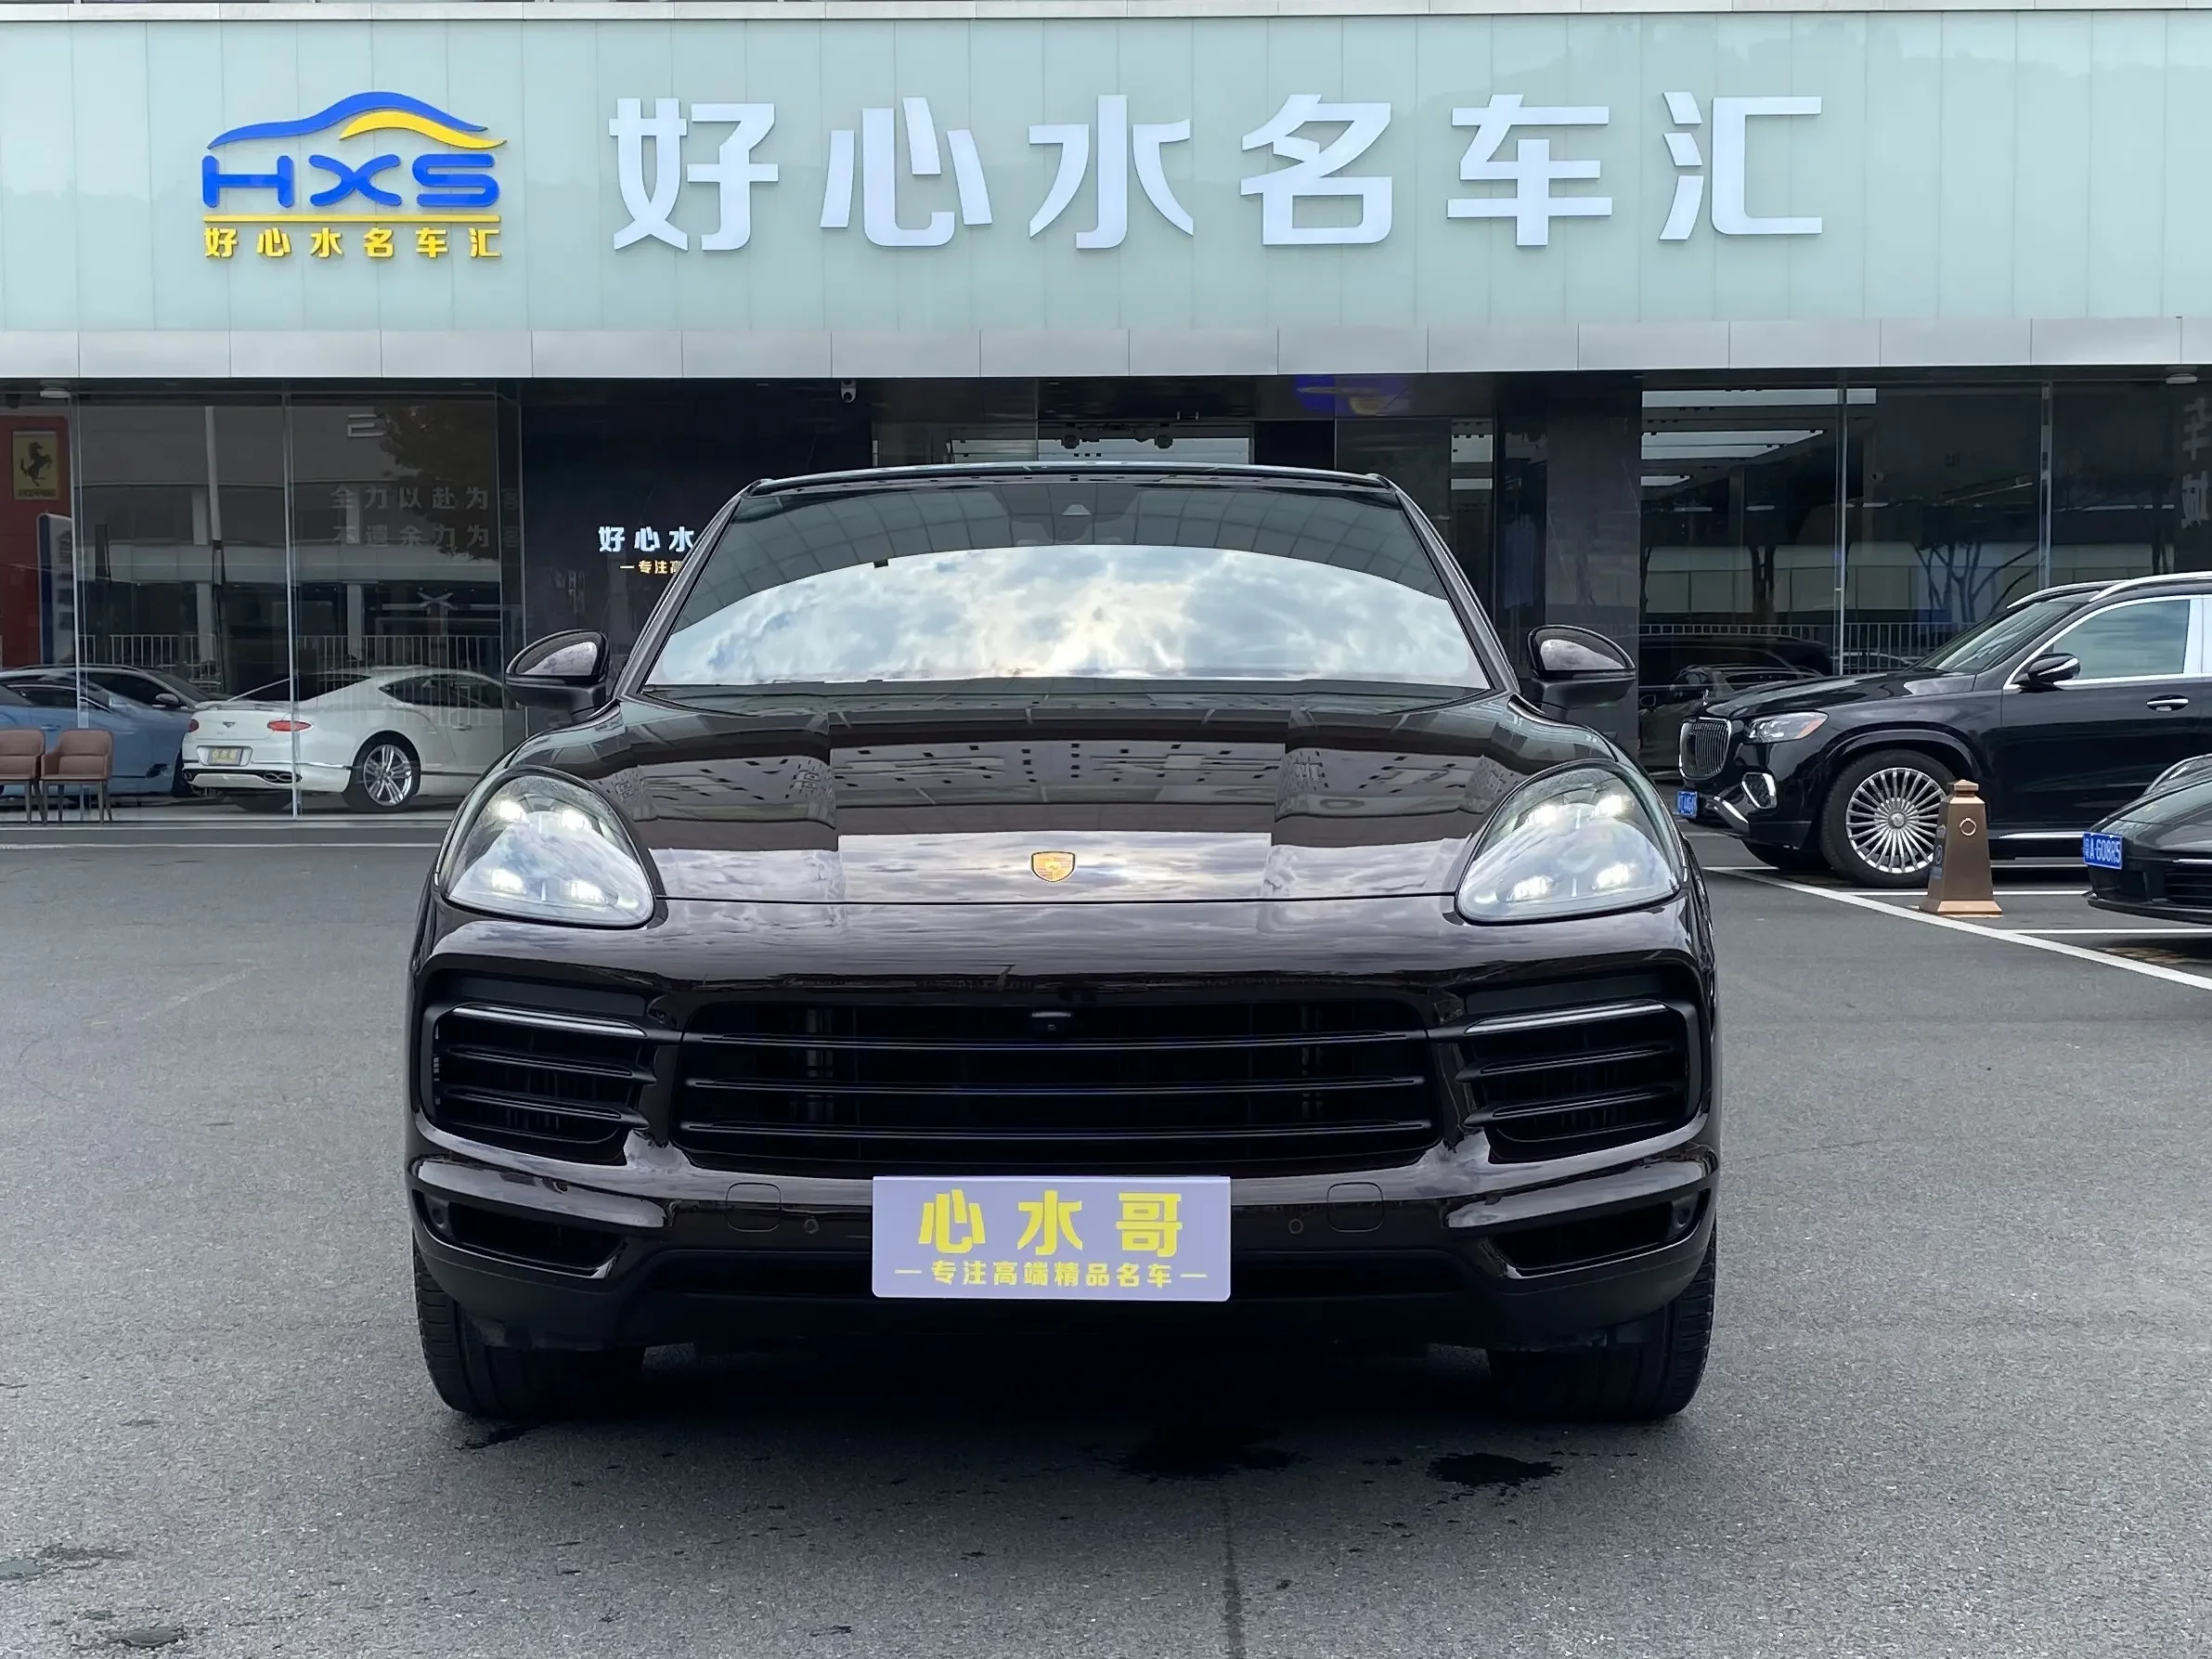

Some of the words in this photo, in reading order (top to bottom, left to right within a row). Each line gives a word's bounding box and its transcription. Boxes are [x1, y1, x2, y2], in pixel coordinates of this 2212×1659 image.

[201, 153, 500, 208] HXS
[608, 91, 1823, 252] 好心水名车汇
[204, 227, 502, 258] 好心水名车汇
[599, 526, 694, 552] 好心水
[917, 1188, 1183, 1258] 心水哥
